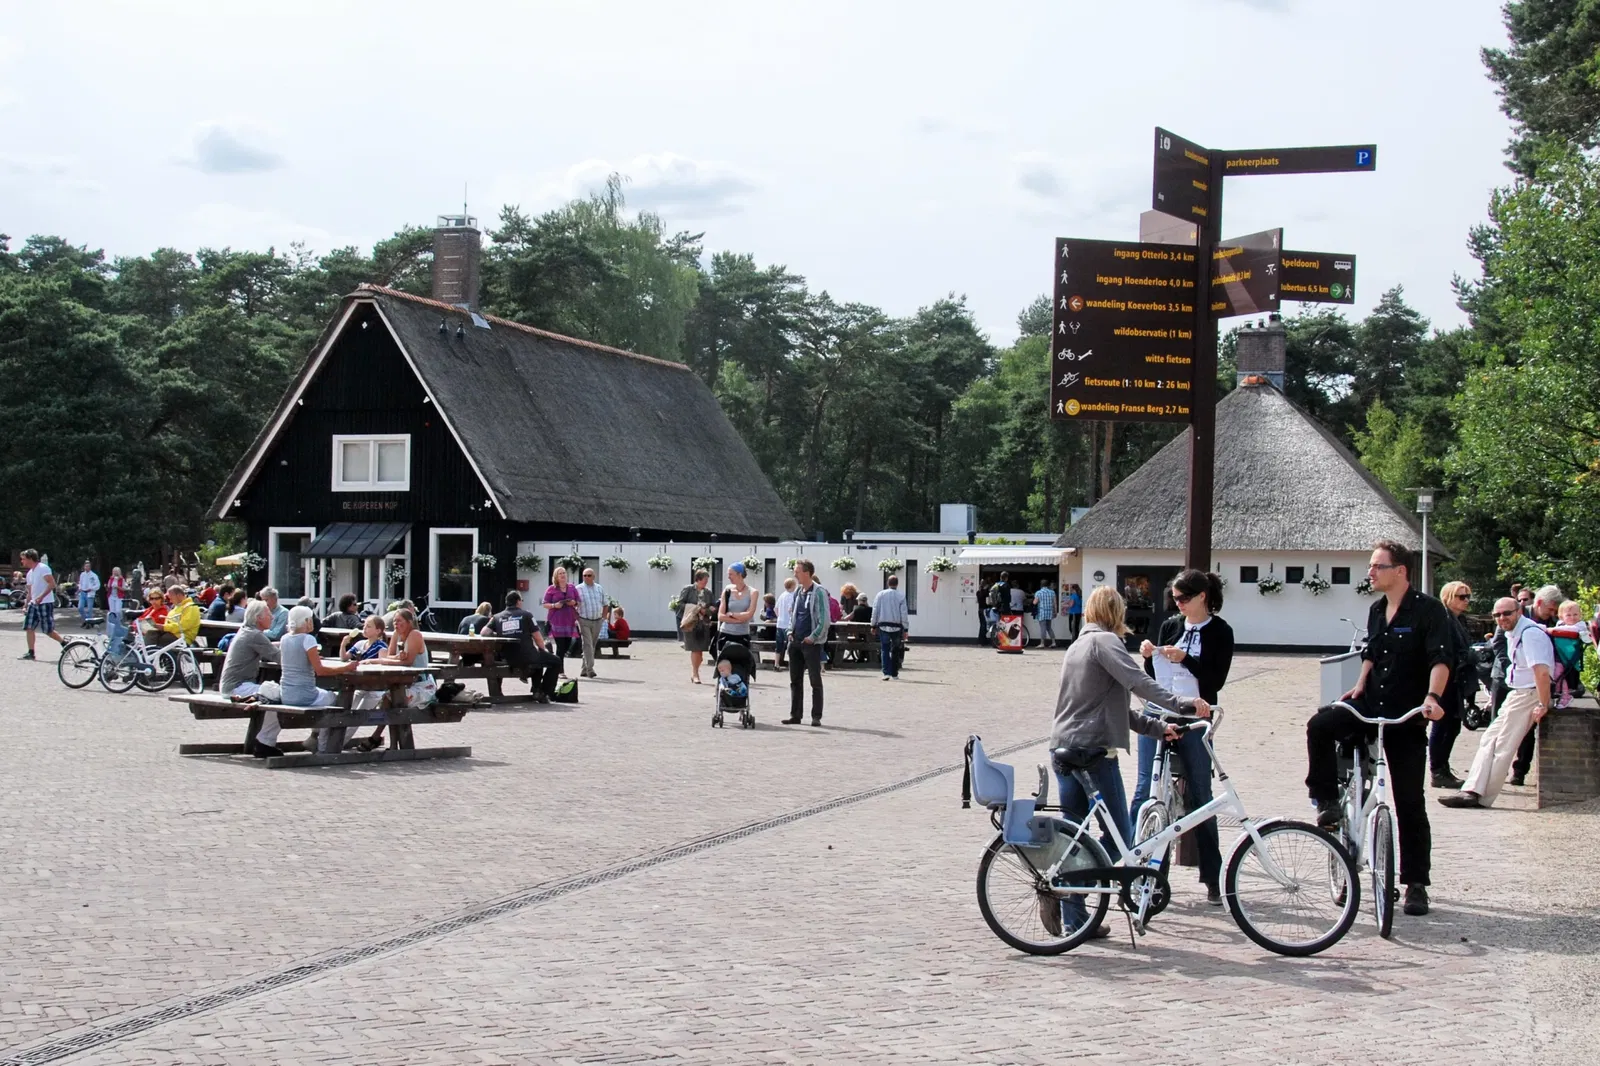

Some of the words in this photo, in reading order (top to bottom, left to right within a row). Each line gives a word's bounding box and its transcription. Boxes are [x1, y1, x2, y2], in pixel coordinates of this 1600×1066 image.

[1226, 157, 1279, 168] parkeerplaats
[1114, 248, 1140, 260] ingang
[1142, 250, 1168, 260] Otterlo
[1170, 252, 1181, 261] 3,4
[1183, 253, 1194, 261] km
[1097, 274, 1122, 285] ingang
[1125, 276, 1167, 286] Hoenderloo
[1169, 279, 1180, 287] 4,0
[1183, 279, 1193, 287] km
[1086, 299, 1125, 311] wandeling
[1128, 302, 1166, 311] Koeverbos
[1168, 304, 1179, 312] 3,5
[1182, 304, 1192, 312] km
[1114, 328, 1168, 337] wildobservatie
[1170, 330, 1176, 338] (1
[1178, 331, 1191, 339] km)
[1146, 355, 1164, 363] witte
[1166, 356, 1190, 364] fietsen
[1085, 377, 1120, 386] fietsroute
[1122, 379, 1131, 388] (1:
[1144, 380, 1155, 388] km
[1166, 381, 1174, 389] 26
[1177, 381, 1190, 390] km)
[1081, 403, 1119, 413] wandeling
[1121, 404, 1144, 412] Franse
[1147, 405, 1163, 415] Berg
[1165, 406, 1176, 414] 2,7
[1178, 406, 1189, 414] km
